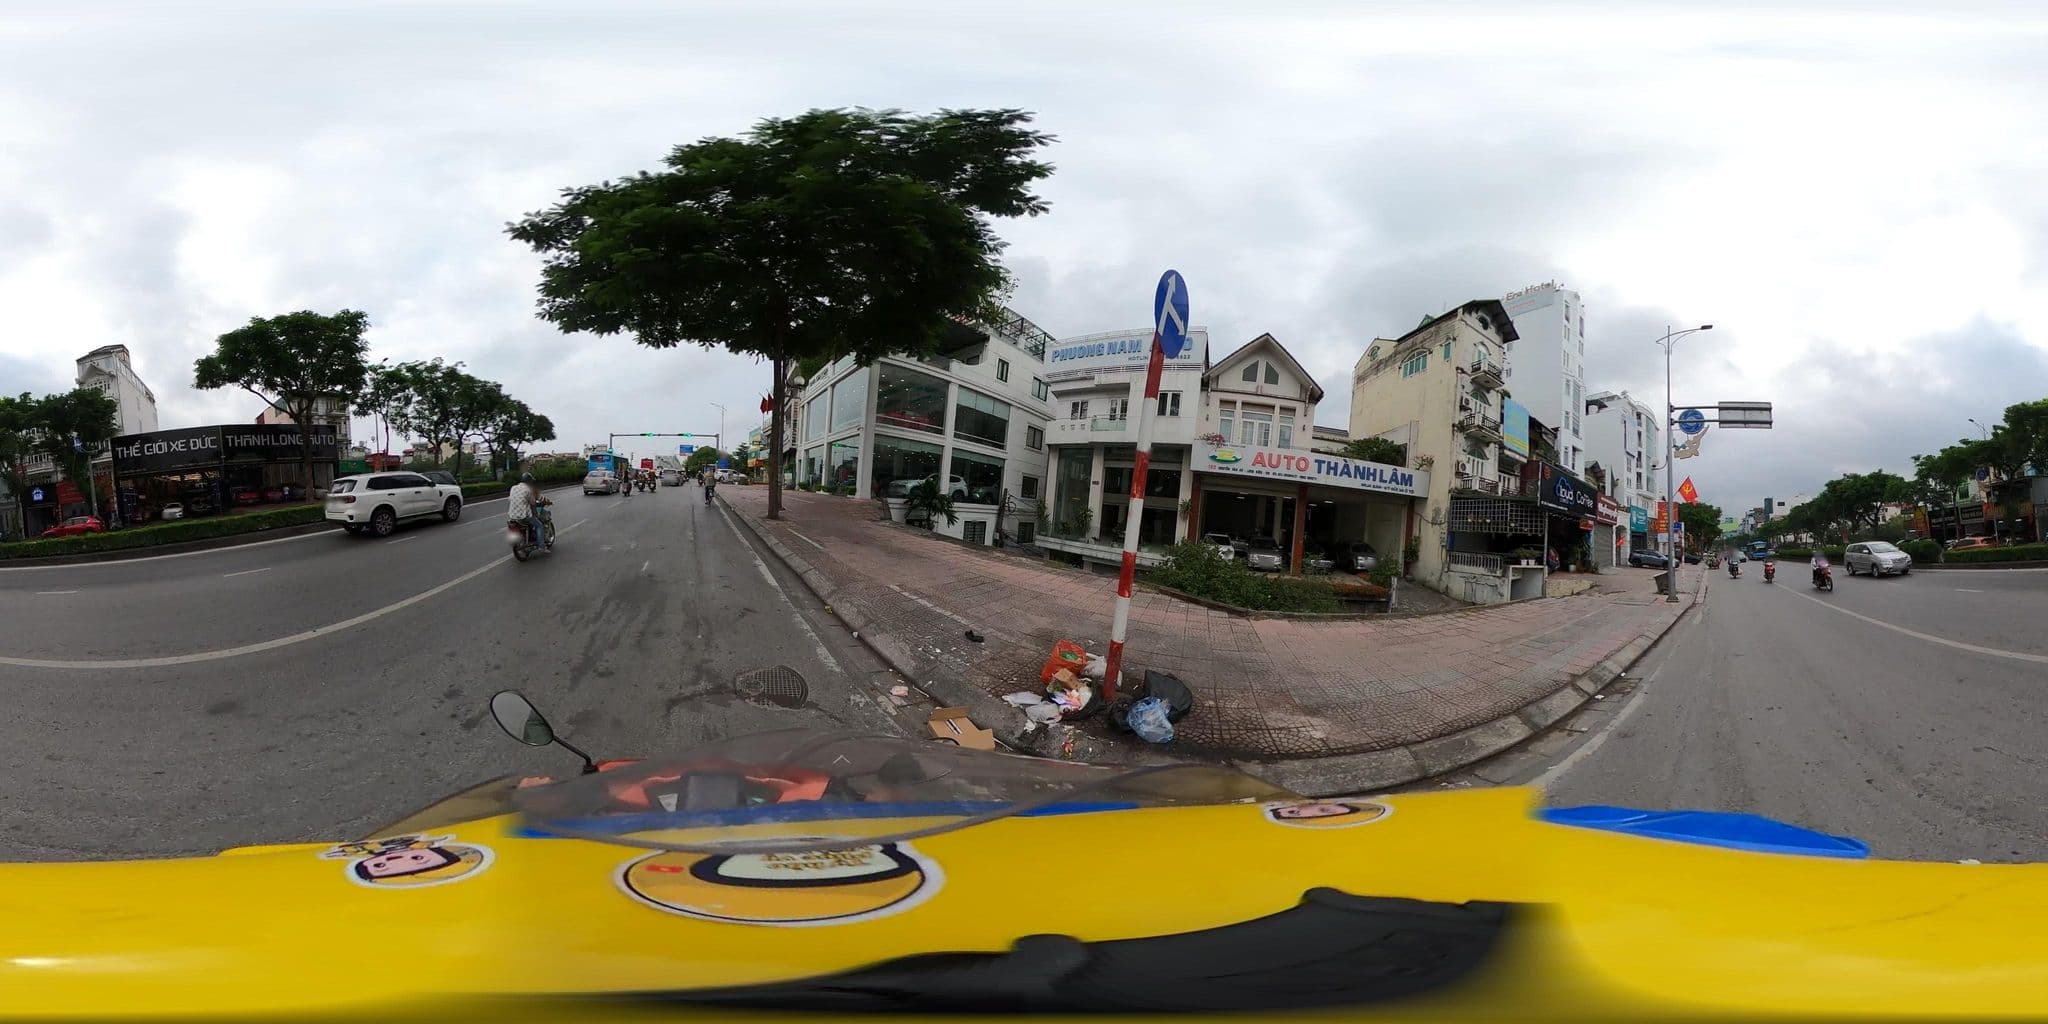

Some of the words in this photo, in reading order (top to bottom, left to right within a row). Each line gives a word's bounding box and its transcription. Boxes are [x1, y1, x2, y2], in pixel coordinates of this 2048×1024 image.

[1525, 279, 1554, 293] Hotel
[1107, 339, 1142, 355] NAM
[115, 440, 142, 459] THẾ
[144, 439, 168, 456] GIỚI
[169, 439, 187, 452] XE
[190, 435, 218, 450] ĐỨC
[271, 434, 304, 446] LONG
[1251, 451, 1310, 472] AUTO
[1314, 459, 1377, 482] THÀNH
[1379, 468, 1413, 487] LÂM
